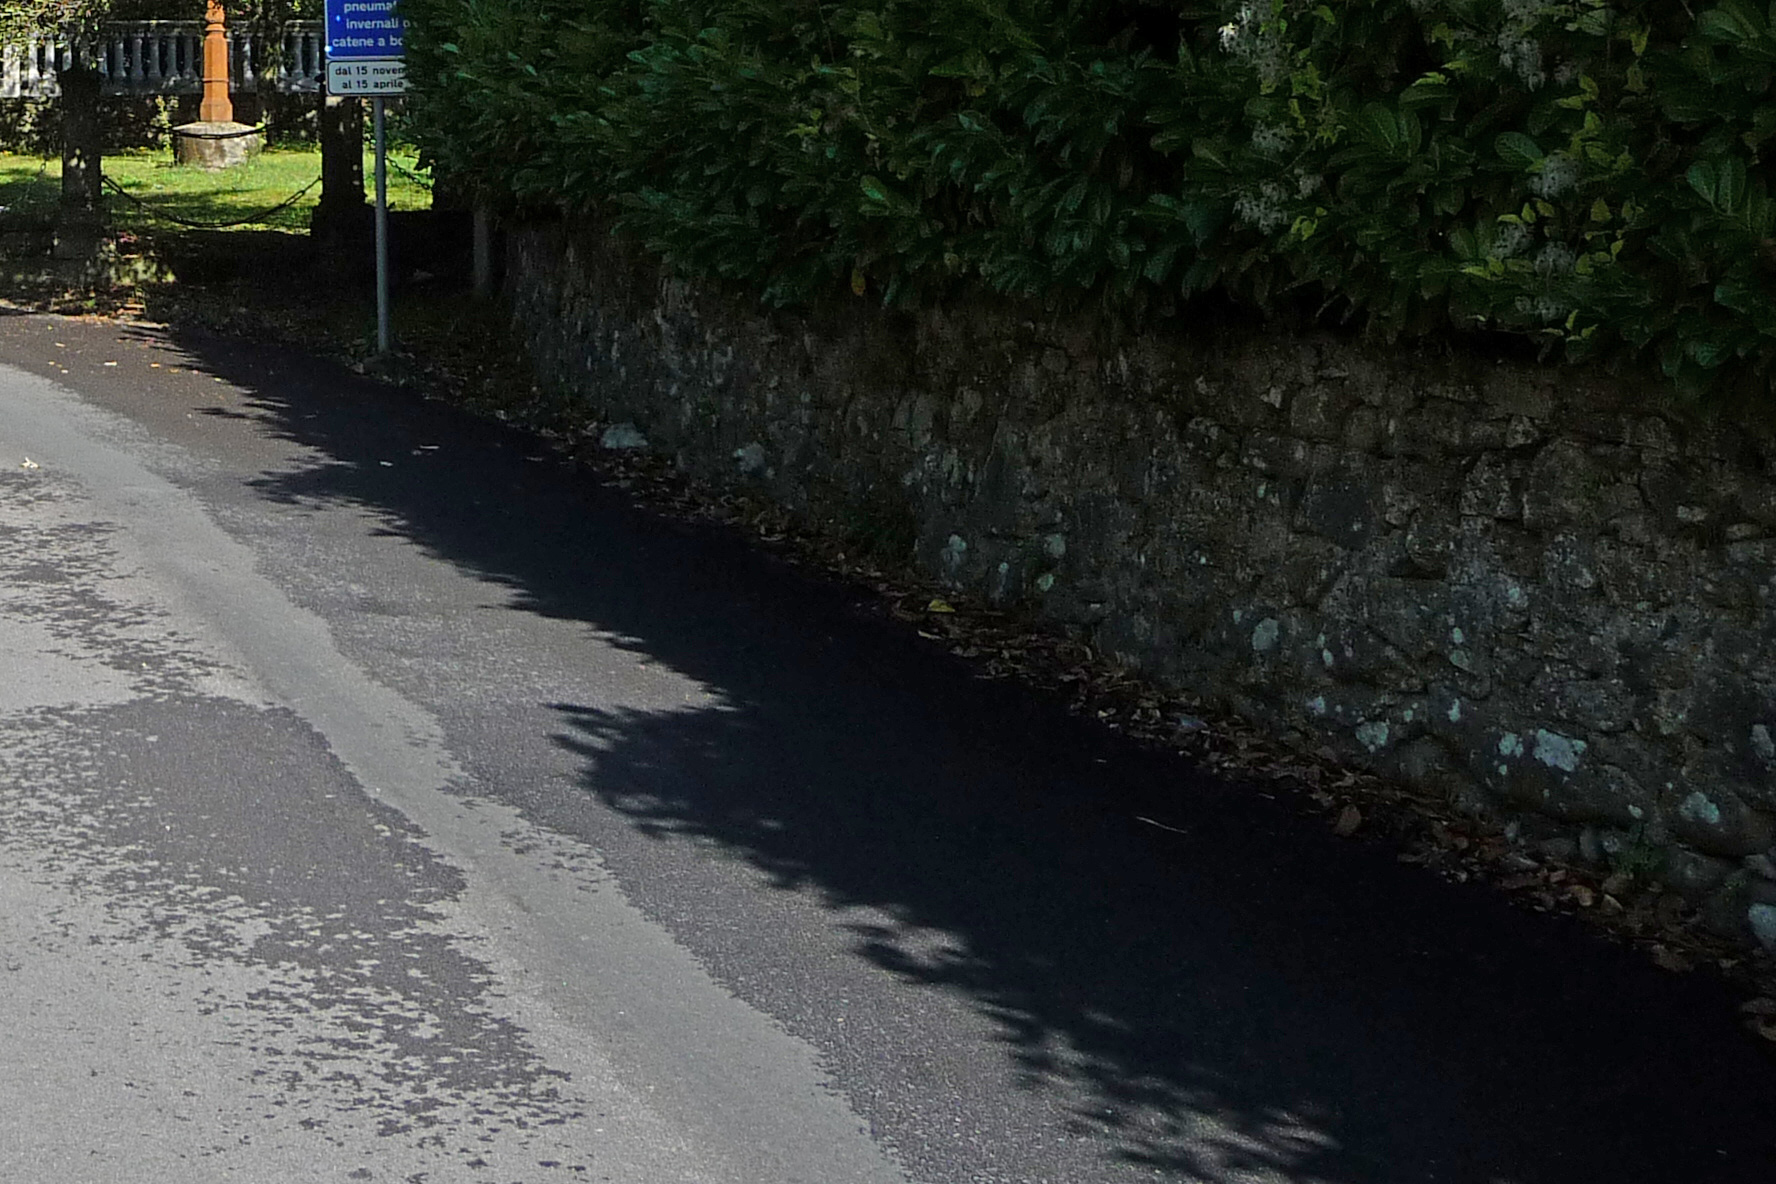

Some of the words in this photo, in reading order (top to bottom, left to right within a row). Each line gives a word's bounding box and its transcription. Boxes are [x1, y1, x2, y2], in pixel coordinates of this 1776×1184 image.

[346, 17, 399, 29] invernali
[332, 36, 374, 47] catene
[378, 37, 385, 46] a
[335, 66, 352, 76] dal
[356, 66, 368, 75] 15
[342, 80, 352, 89] al
[356, 80, 368, 89] 15
[373, 79, 404, 89] aprile
